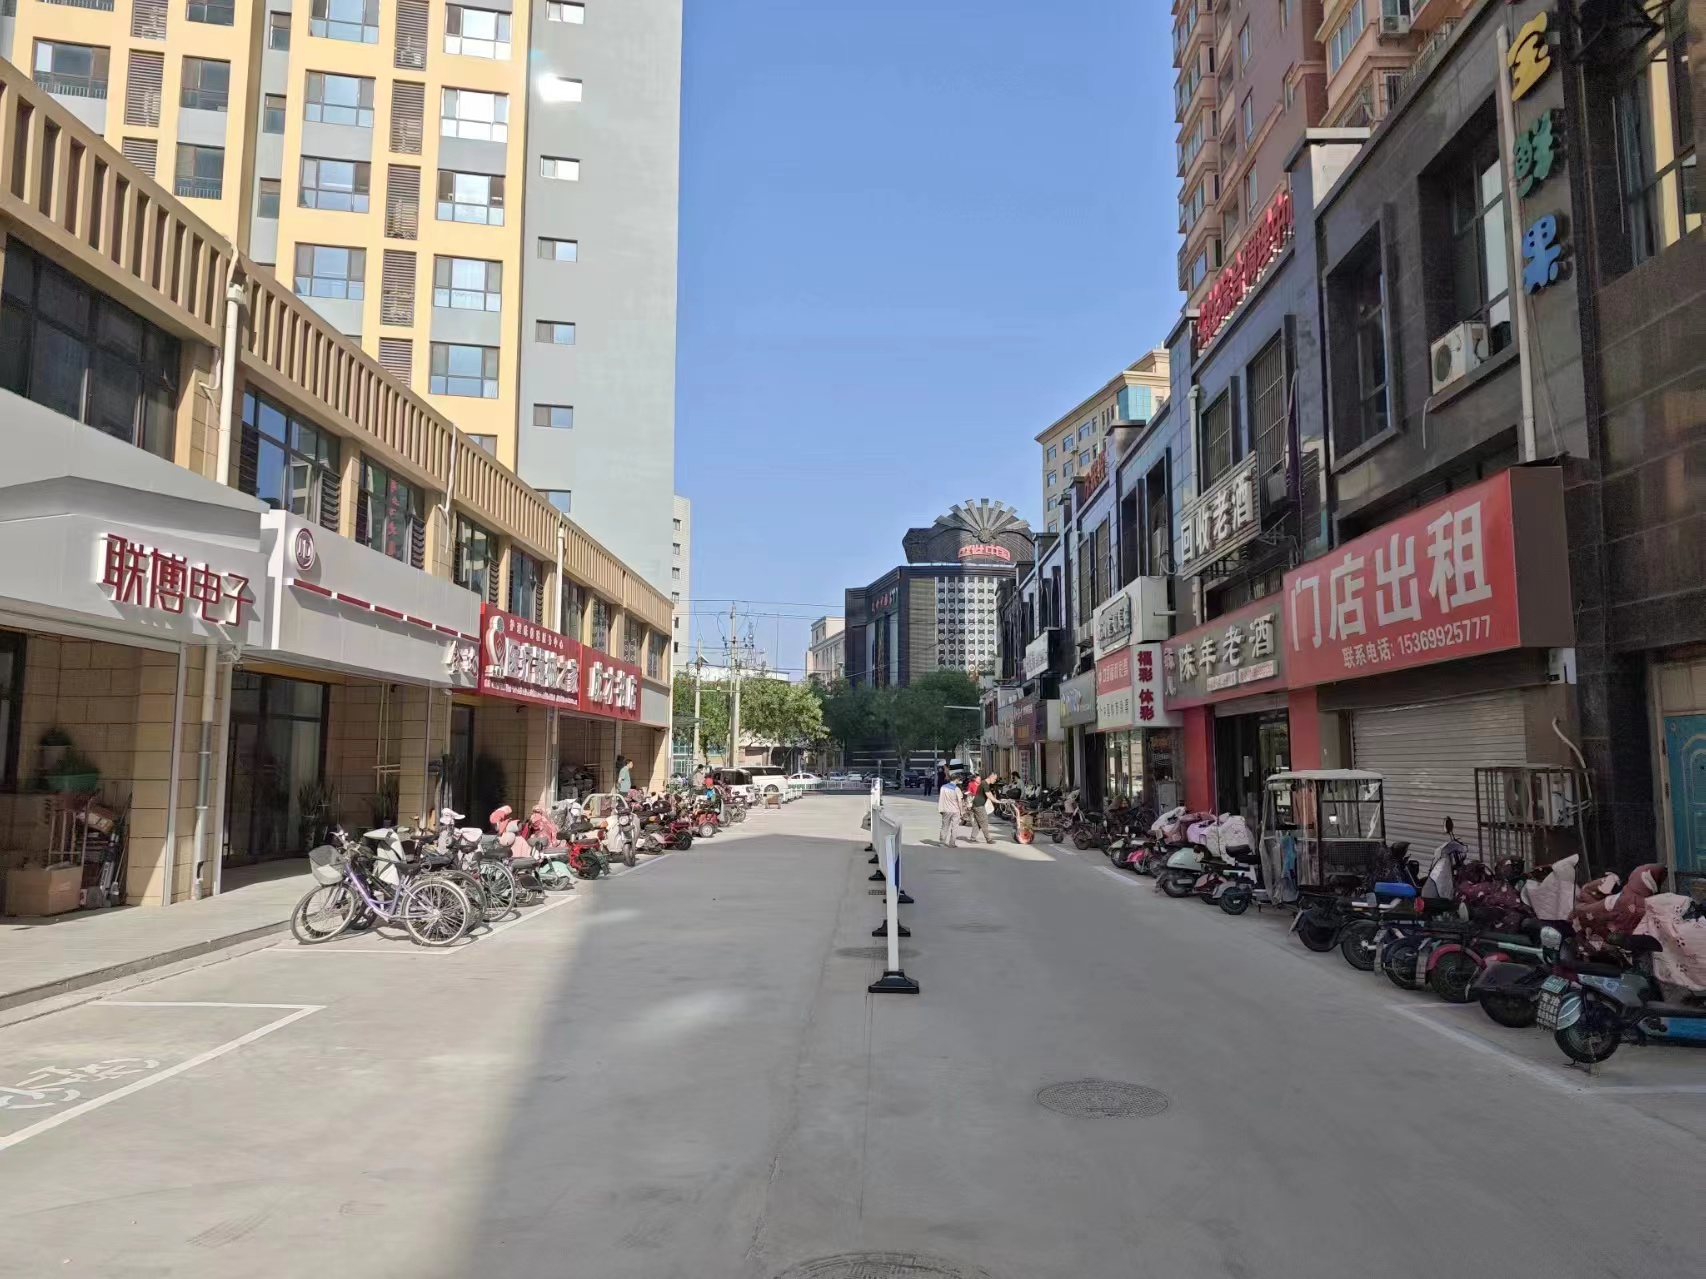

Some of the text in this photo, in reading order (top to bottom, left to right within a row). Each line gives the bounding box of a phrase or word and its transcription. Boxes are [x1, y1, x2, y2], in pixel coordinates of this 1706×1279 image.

[1181, 469, 1254, 563] 回收老酒
[99, 532, 255, 627] 联博电子
[1290, 500, 1493, 652] 门店出租
[1178, 613, 1275, 683] 陈年老酒
[1398, 615, 1492, 656] 15369925777
[1137, 650, 1155, 721] 福彩 体彩
